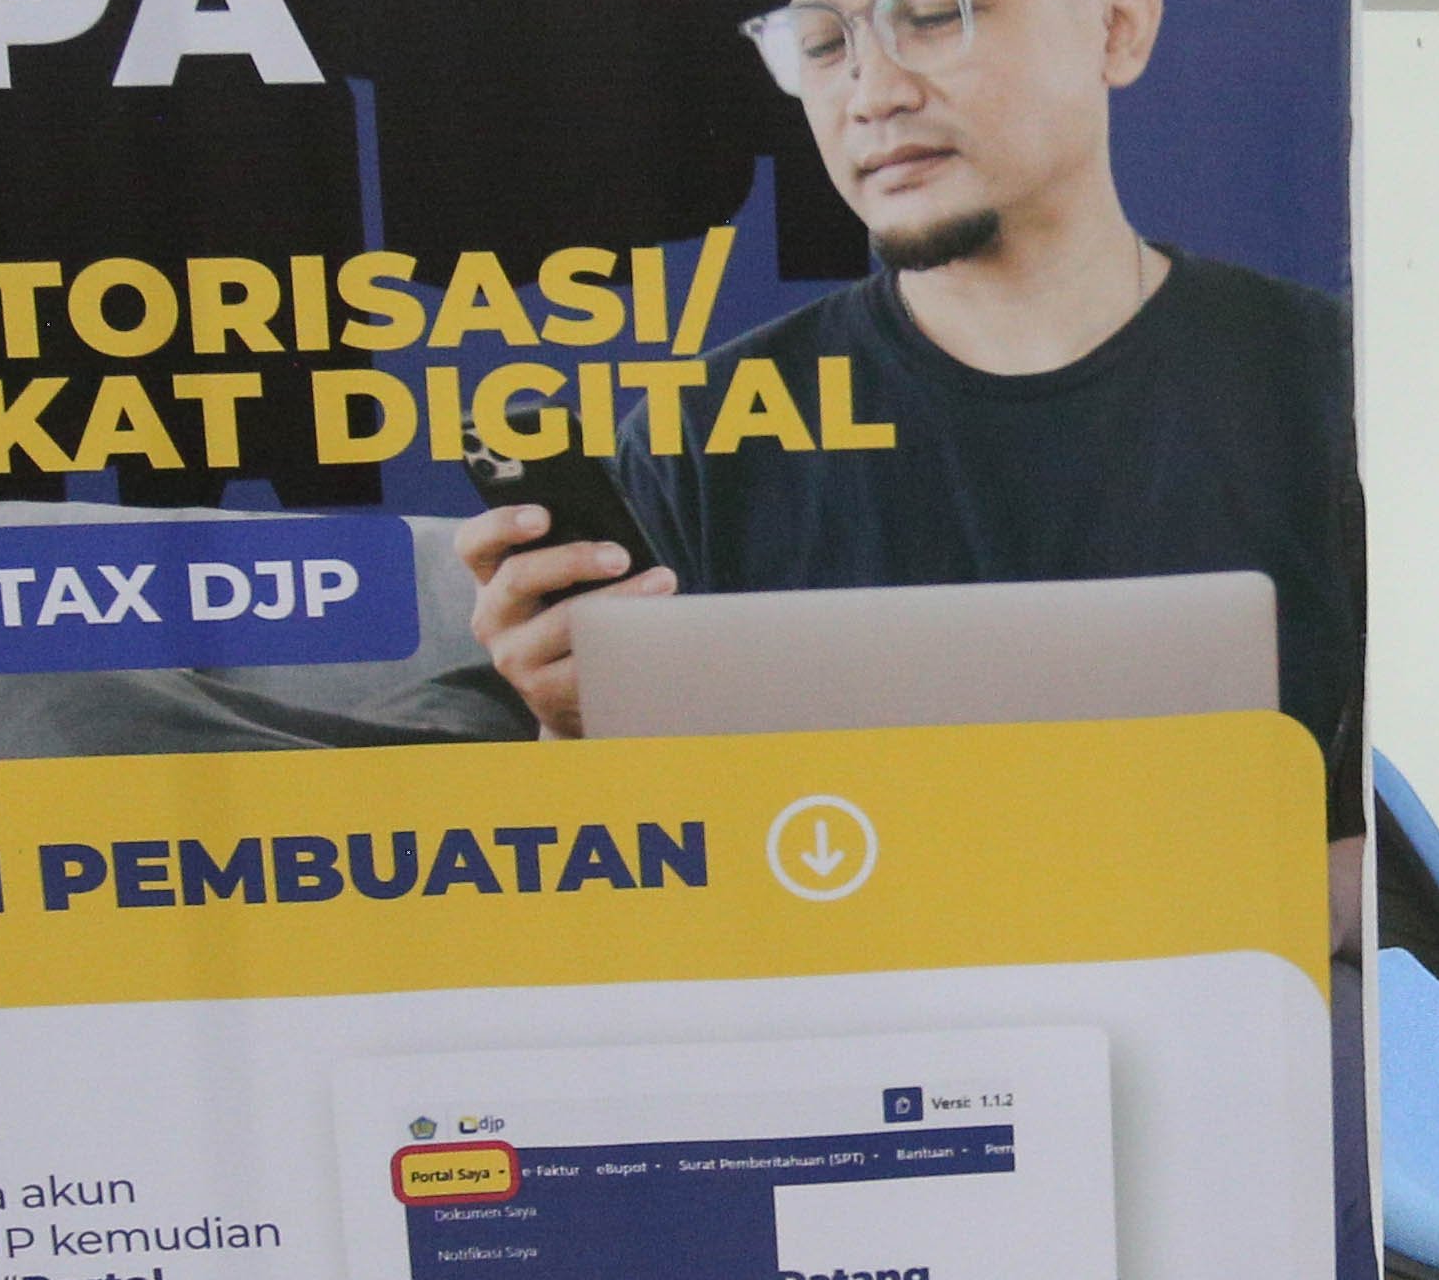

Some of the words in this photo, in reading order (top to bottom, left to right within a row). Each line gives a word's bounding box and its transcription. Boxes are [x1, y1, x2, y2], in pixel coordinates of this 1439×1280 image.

[313, 356, 896, 465] DIGITAL
[189, 559, 359, 621] DJP
[39, 822, 707, 911] PEMBUATAN
[980, 1094, 1013, 1107] 1.1.2
[478, 1116, 505, 1132] djp
[411, 1168, 453, 1183] Portal
[457, 1167, 490, 1182] Saya
[596, 1162, 647, 1176] eBupot
[679, 1157, 715, 1171] Surat
[720, 1152, 824, 1169] Pemberitahuan
[829, 1152, 865, 1167] (SPT)
[897, 1147, 954, 1161] Bantuan
[21, 1175, 135, 1210] akun
[435, 1207, 502, 1221] Dokumen
[505, 1206, 537, 1220] Saya
[50, 1218, 281, 1257] kemudian
[438, 1247, 502, 1262] Notifikasi
[505, 1246, 537, 1260] Saya
